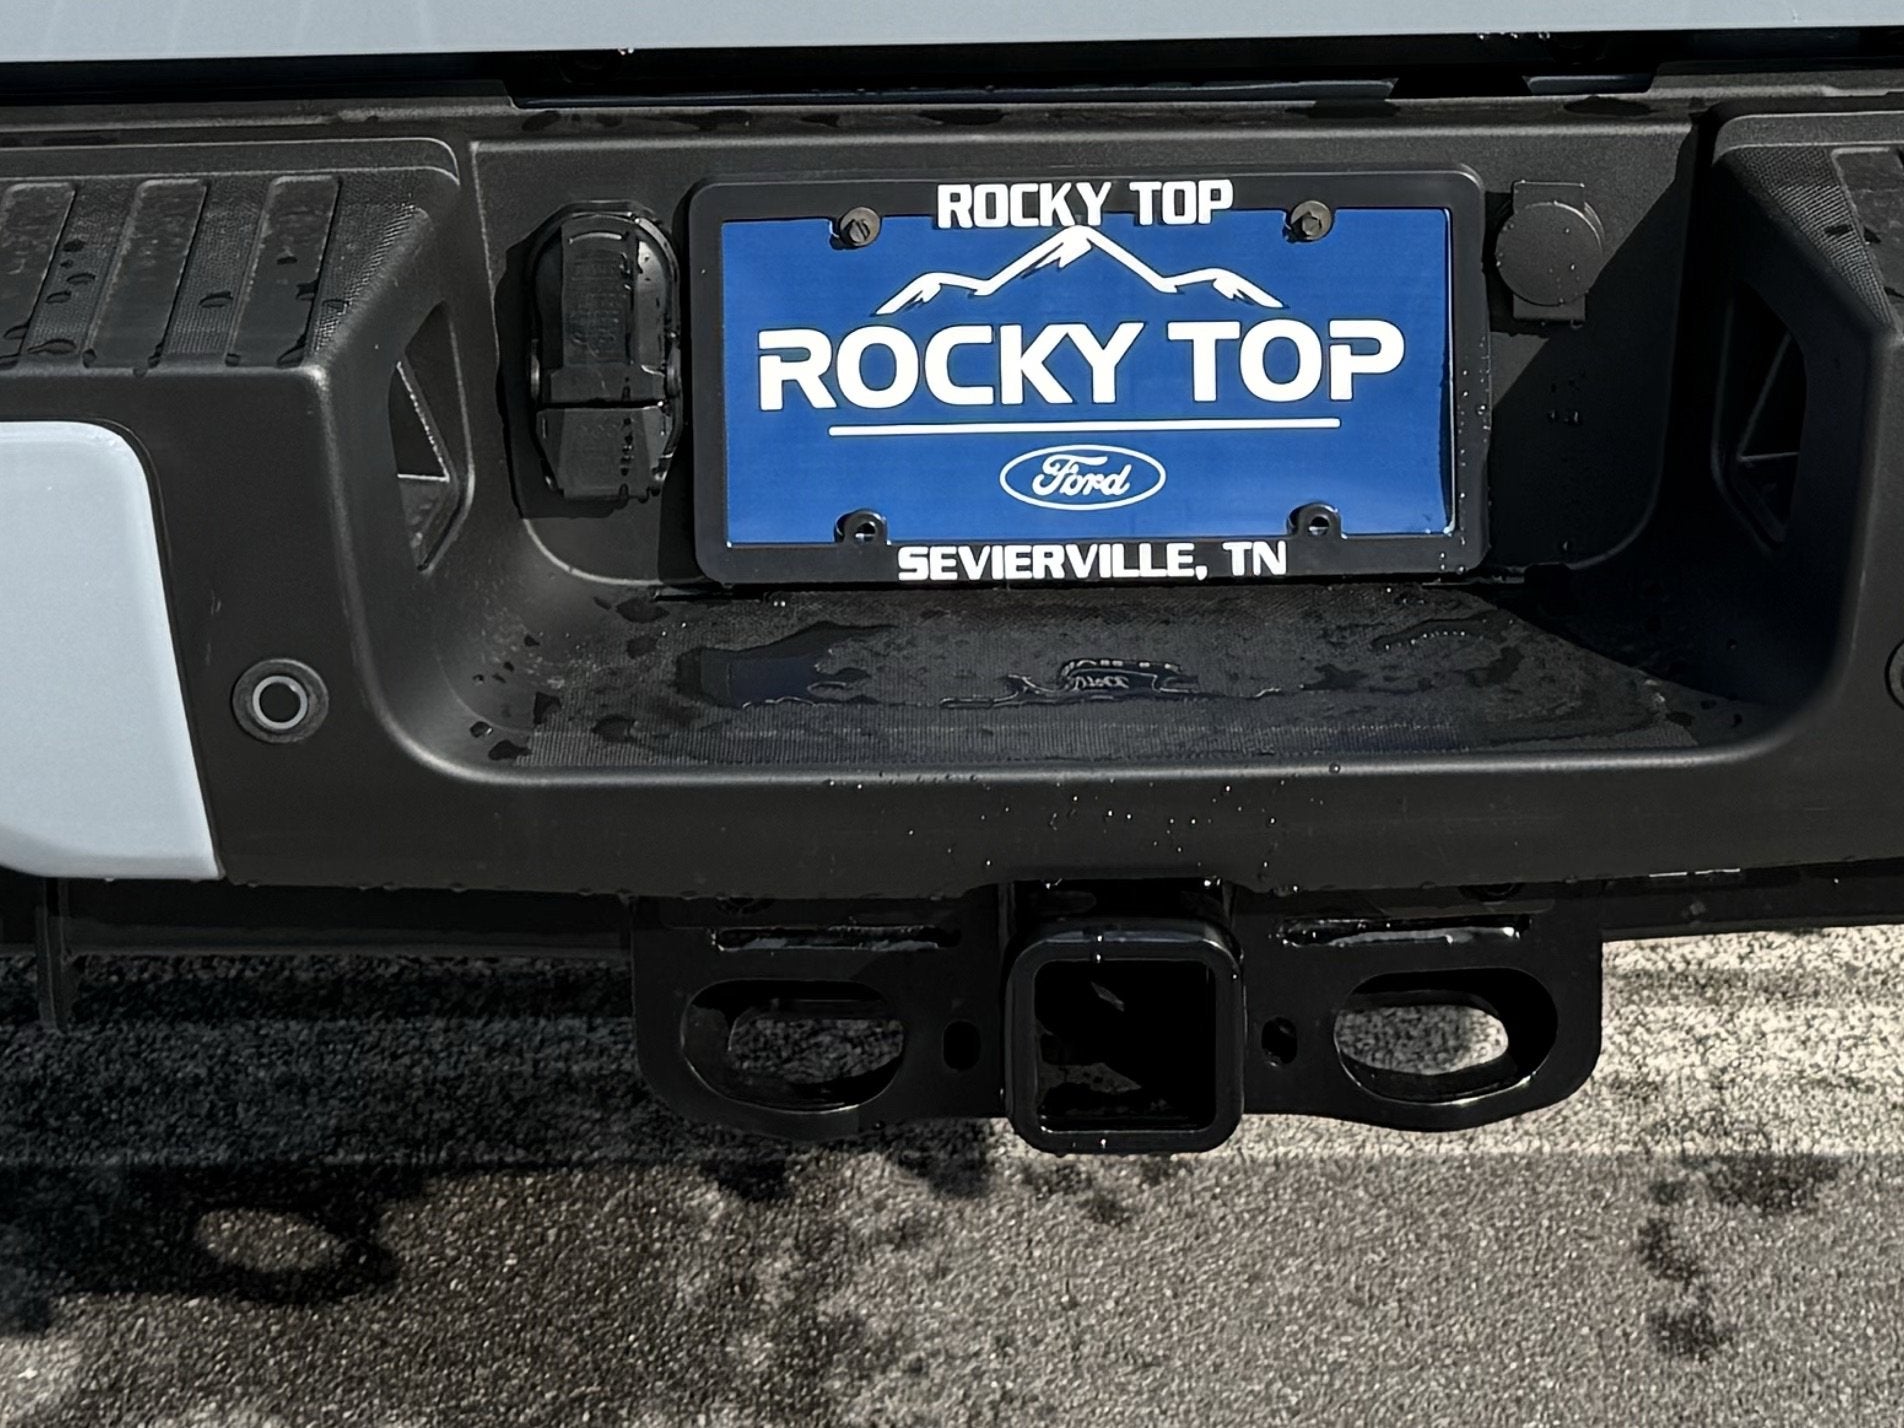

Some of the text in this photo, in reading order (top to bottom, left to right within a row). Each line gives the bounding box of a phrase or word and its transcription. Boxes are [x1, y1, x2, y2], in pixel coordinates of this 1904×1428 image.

[937, 179, 1234, 229] ROCKY TOP
[757, 319, 1406, 412] ROCKY TOP
[1032, 454, 1132, 496] Ford
[897, 540, 1288, 581] SEVIERVILLE, TN
